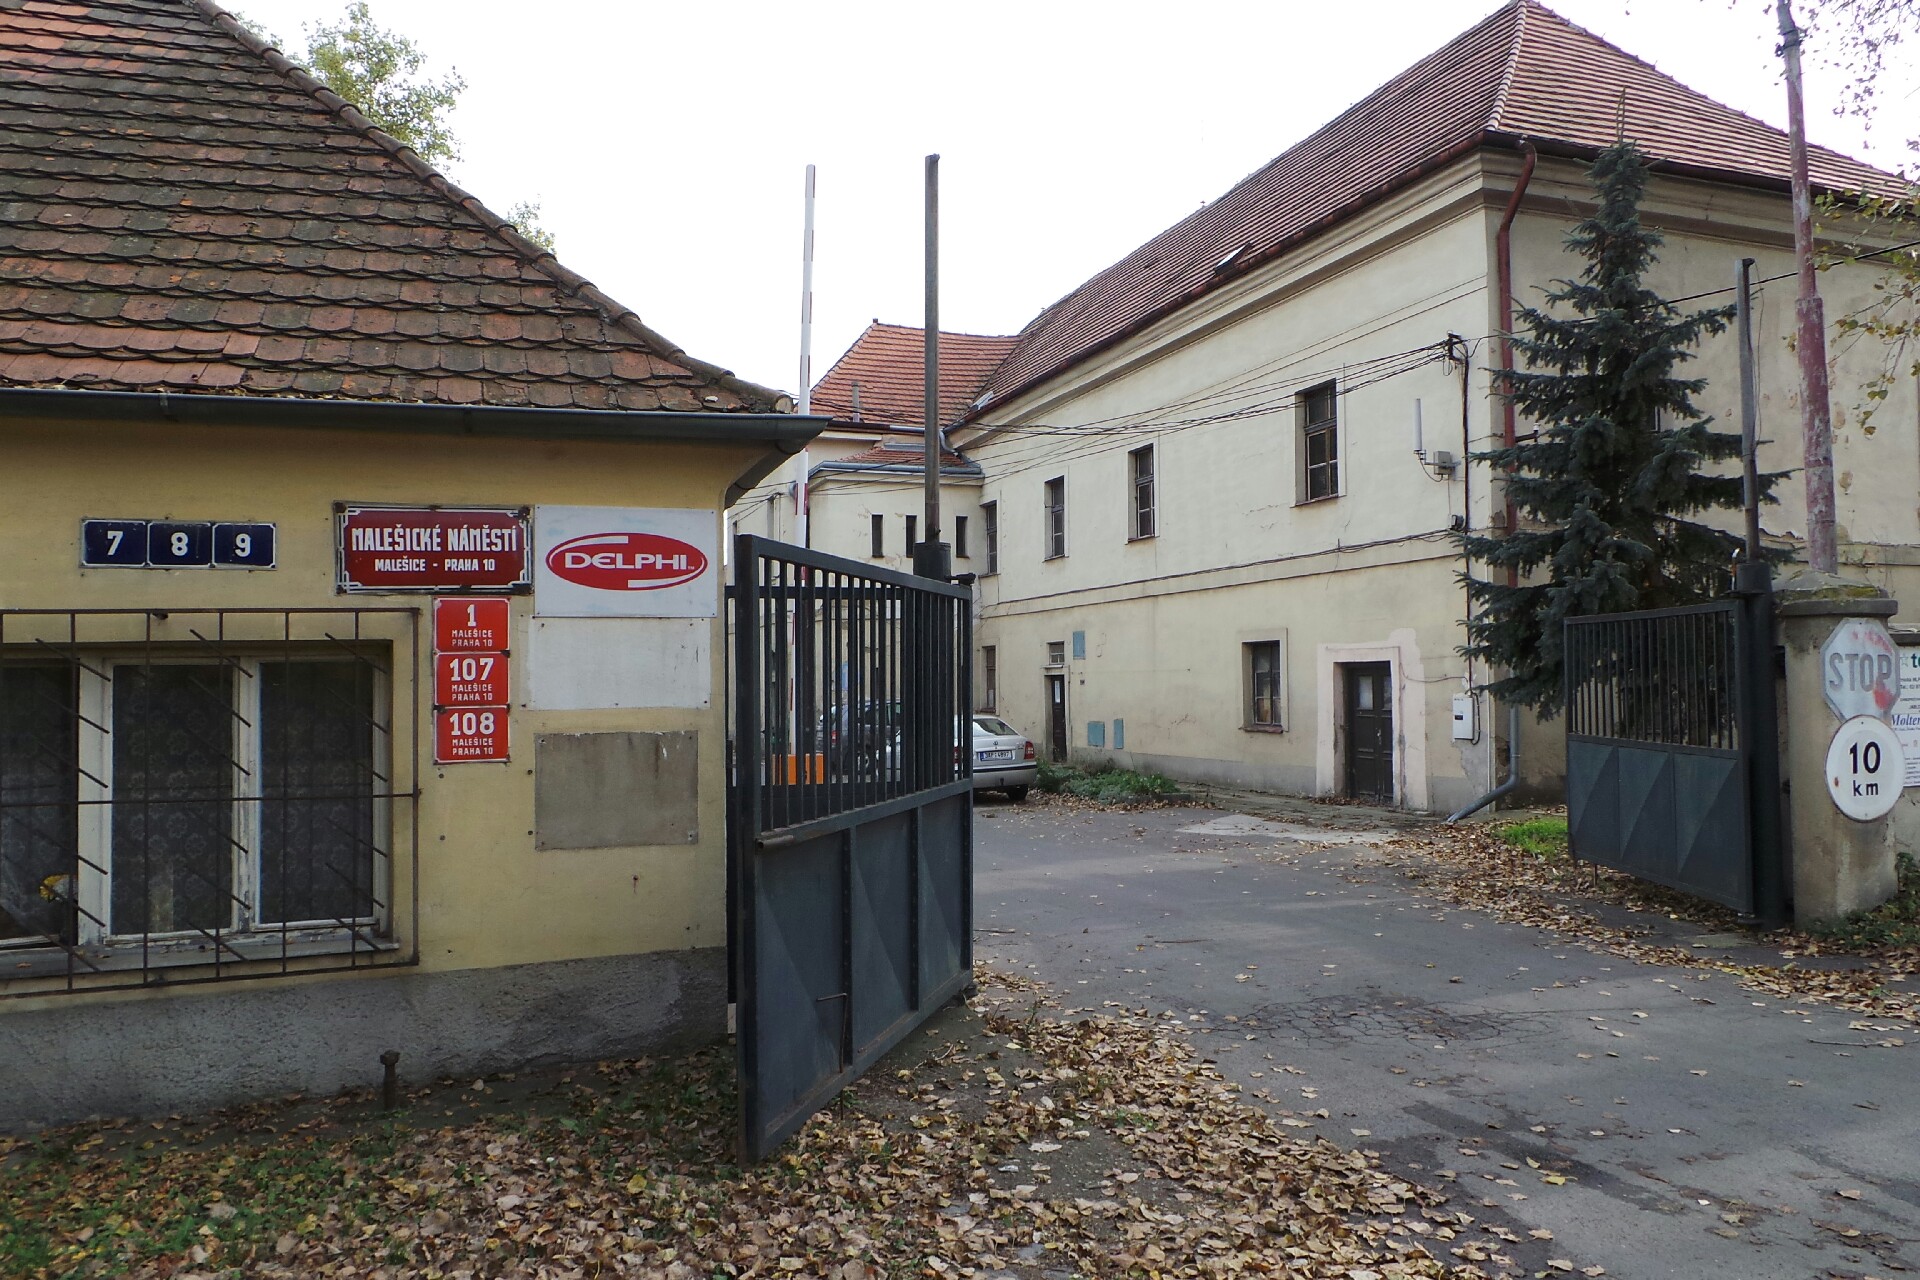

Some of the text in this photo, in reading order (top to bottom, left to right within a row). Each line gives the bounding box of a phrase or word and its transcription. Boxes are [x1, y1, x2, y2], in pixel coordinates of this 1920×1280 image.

[107, 530, 251, 558] 7 8 9
[352, 524, 517, 551] MALEŠICKÉ NÁMĚSTÍ
[375, 555, 426, 572] MALEŠICE
[444, 558, 479, 572] PRAHA
[482, 558, 496, 572] 10
[564, 552, 687, 570] DELPHI
[466, 604, 477, 627] 1
[451, 629, 493, 638] MALEŠICE
[451, 639, 493, 647] PRAHA 10
[449, 657, 494, 682] 107
[1829, 652, 1892, 692] STOP
[451, 683, 493, 692] MALEŠICE
[451, 692, 493, 701] PRAHA 10
[449, 712, 495, 736] 108
[452, 737, 493, 746] MALEŠICE
[452, 747, 494, 756] PRAHA 10
[1849, 741, 1881, 775] 10
[1852, 780, 1879, 797] km
